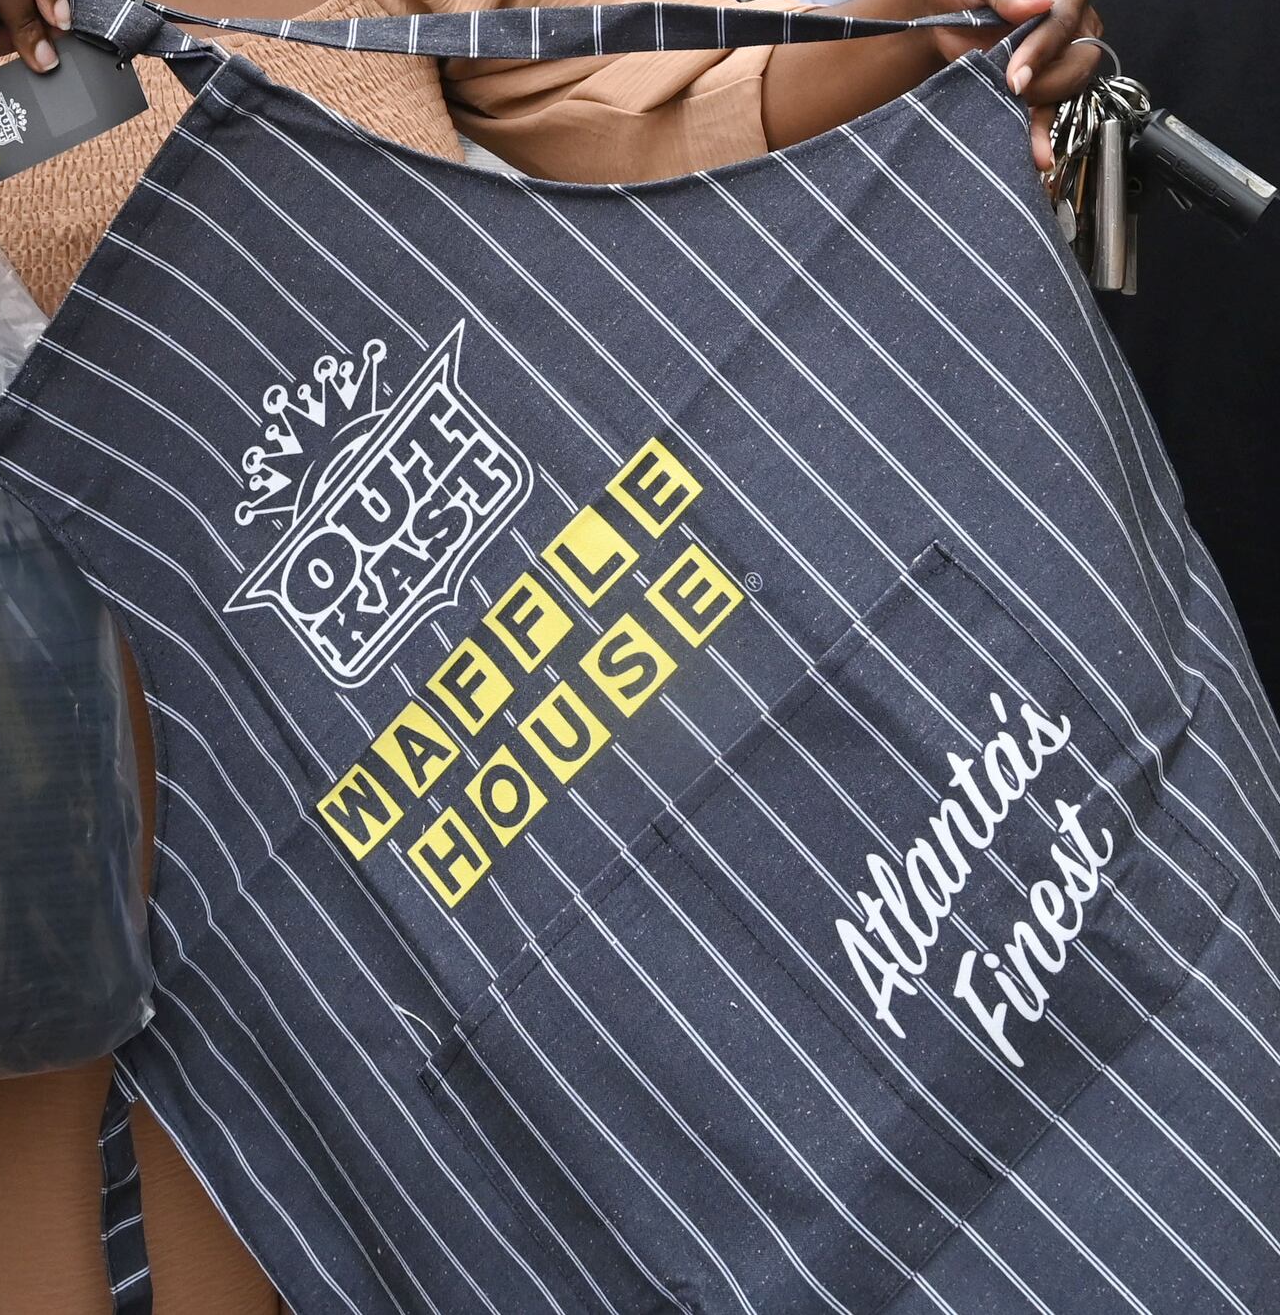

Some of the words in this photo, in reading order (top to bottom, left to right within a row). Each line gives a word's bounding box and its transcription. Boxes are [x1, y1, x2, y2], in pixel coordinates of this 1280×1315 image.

[280, 382, 485, 622] OUT
[312, 430, 520, 677] KAST
[318, 439, 702, 859] WAFFLE
[410, 545, 742, 906] HOUSE
[835, 692, 1071, 1039] Atlanta's
[953, 798, 1113, 1068] Finest
